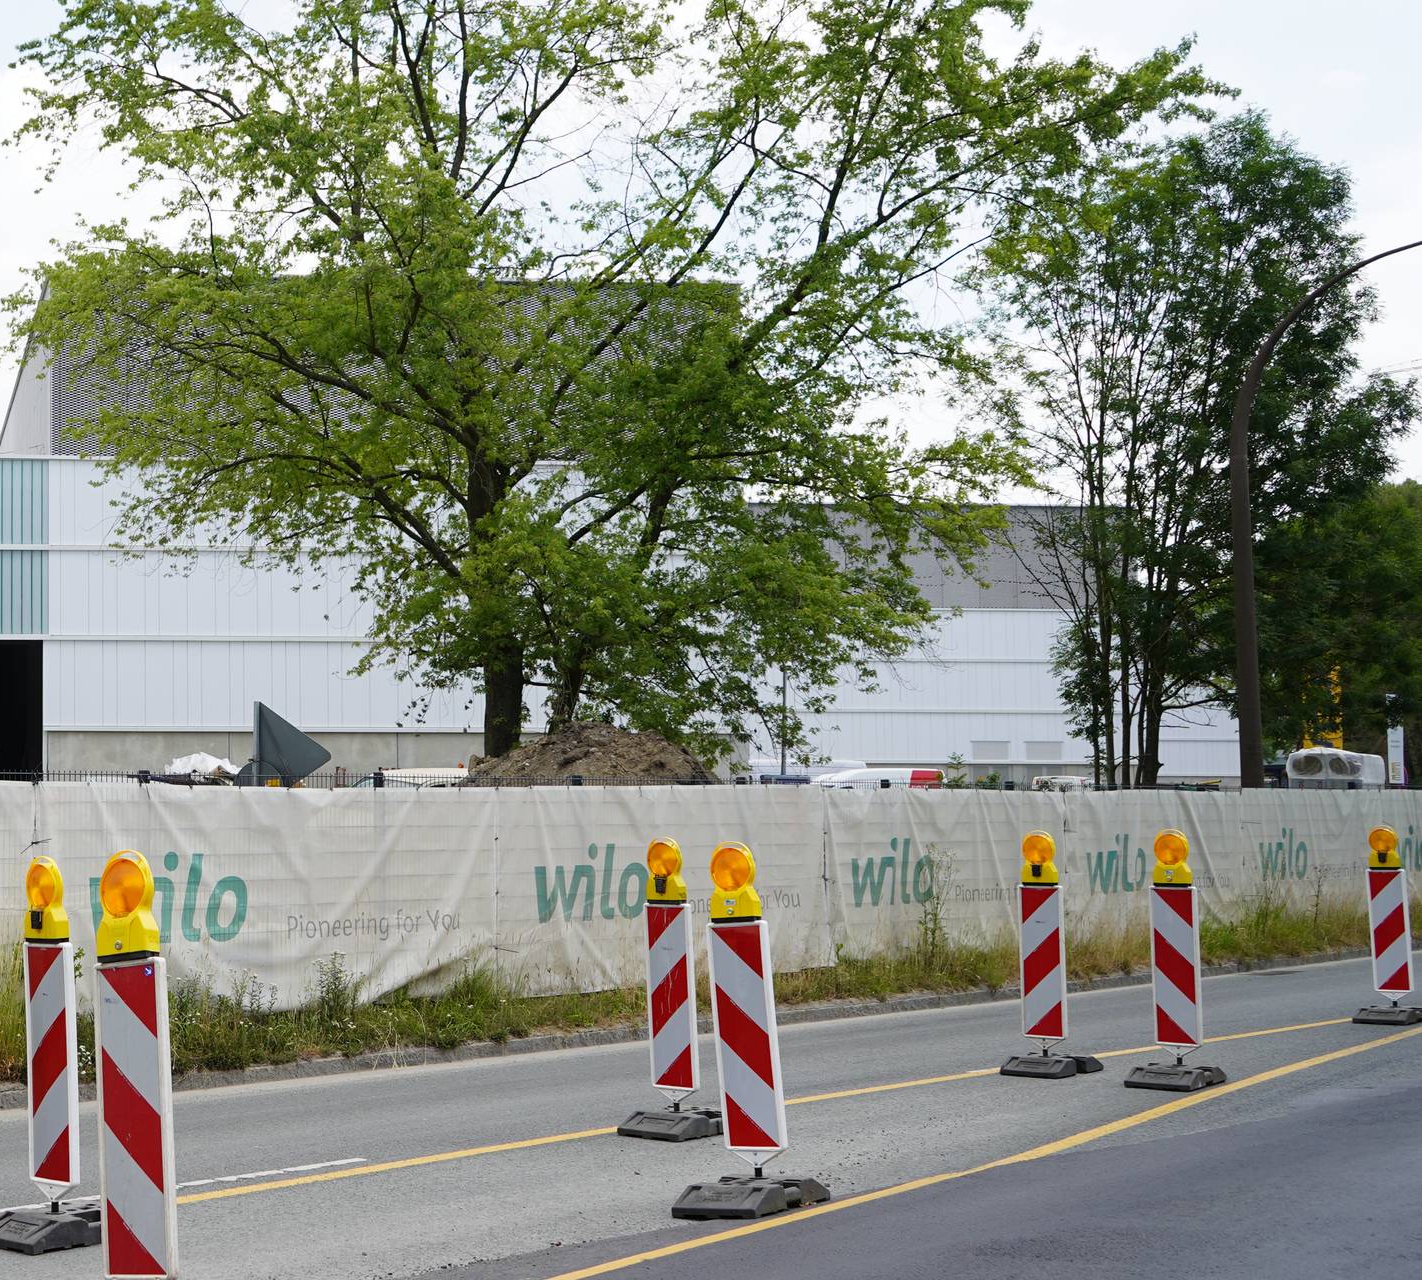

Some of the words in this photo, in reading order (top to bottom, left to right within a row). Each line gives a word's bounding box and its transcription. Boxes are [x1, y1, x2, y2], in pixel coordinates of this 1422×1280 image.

[851, 837, 934, 908] wilo
[1086, 833, 1146, 896] wilo
[1259, 827, 1308, 881] wilo
[534, 843, 649, 924] wilo
[773, 889, 801, 908] You
[287, 912, 389, 941] Pioneering
[395, 909, 422, 933] for
[425, 909, 460, 931] You
